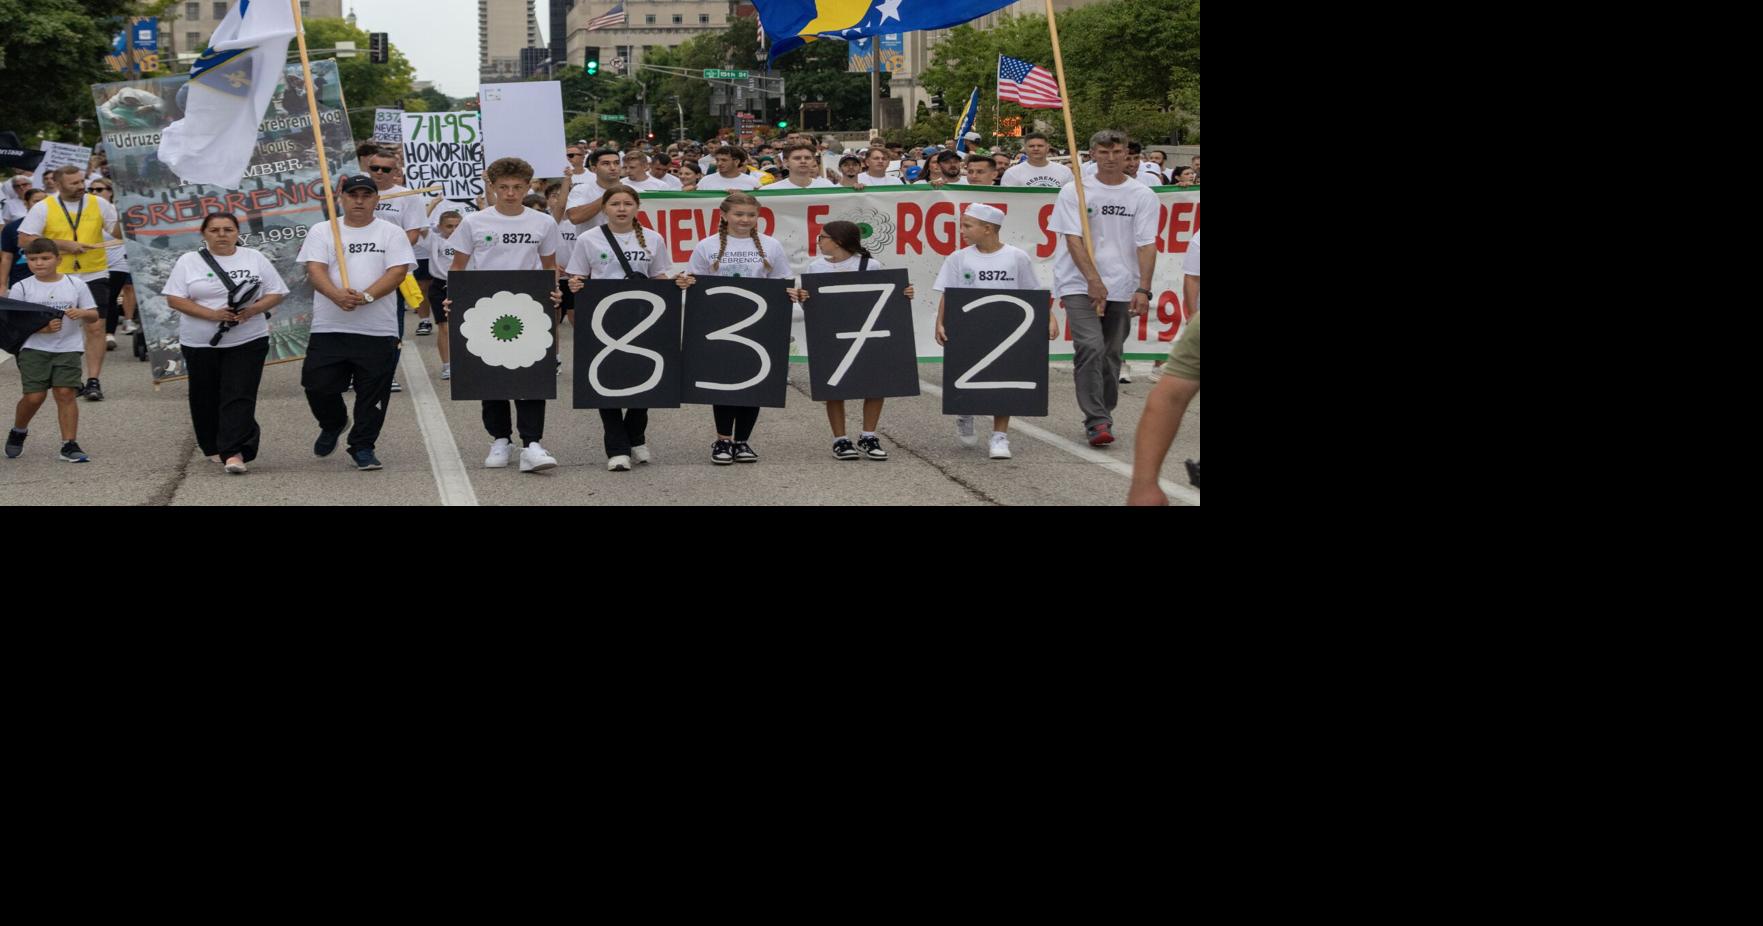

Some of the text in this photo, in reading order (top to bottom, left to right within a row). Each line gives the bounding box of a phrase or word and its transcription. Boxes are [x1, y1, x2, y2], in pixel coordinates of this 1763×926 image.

[374, 132, 402, 142] FORGE
[407, 113, 477, 144] 7-11-95
[258, 139, 295, 155] Louis
[404, 142, 483, 164] HONORING
[406, 161, 483, 181] GENOCIDE
[258, 224, 308, 244] 1995
[502, 232, 539, 245] 8372...
[348, 242, 385, 254] 8372...
[978, 270, 1014, 282] 8372...
[588, 289, 667, 397] 8
[695, 285, 772, 391] 3
[818, 283, 896, 387] 7
[954, 294, 1037, 389] 2
